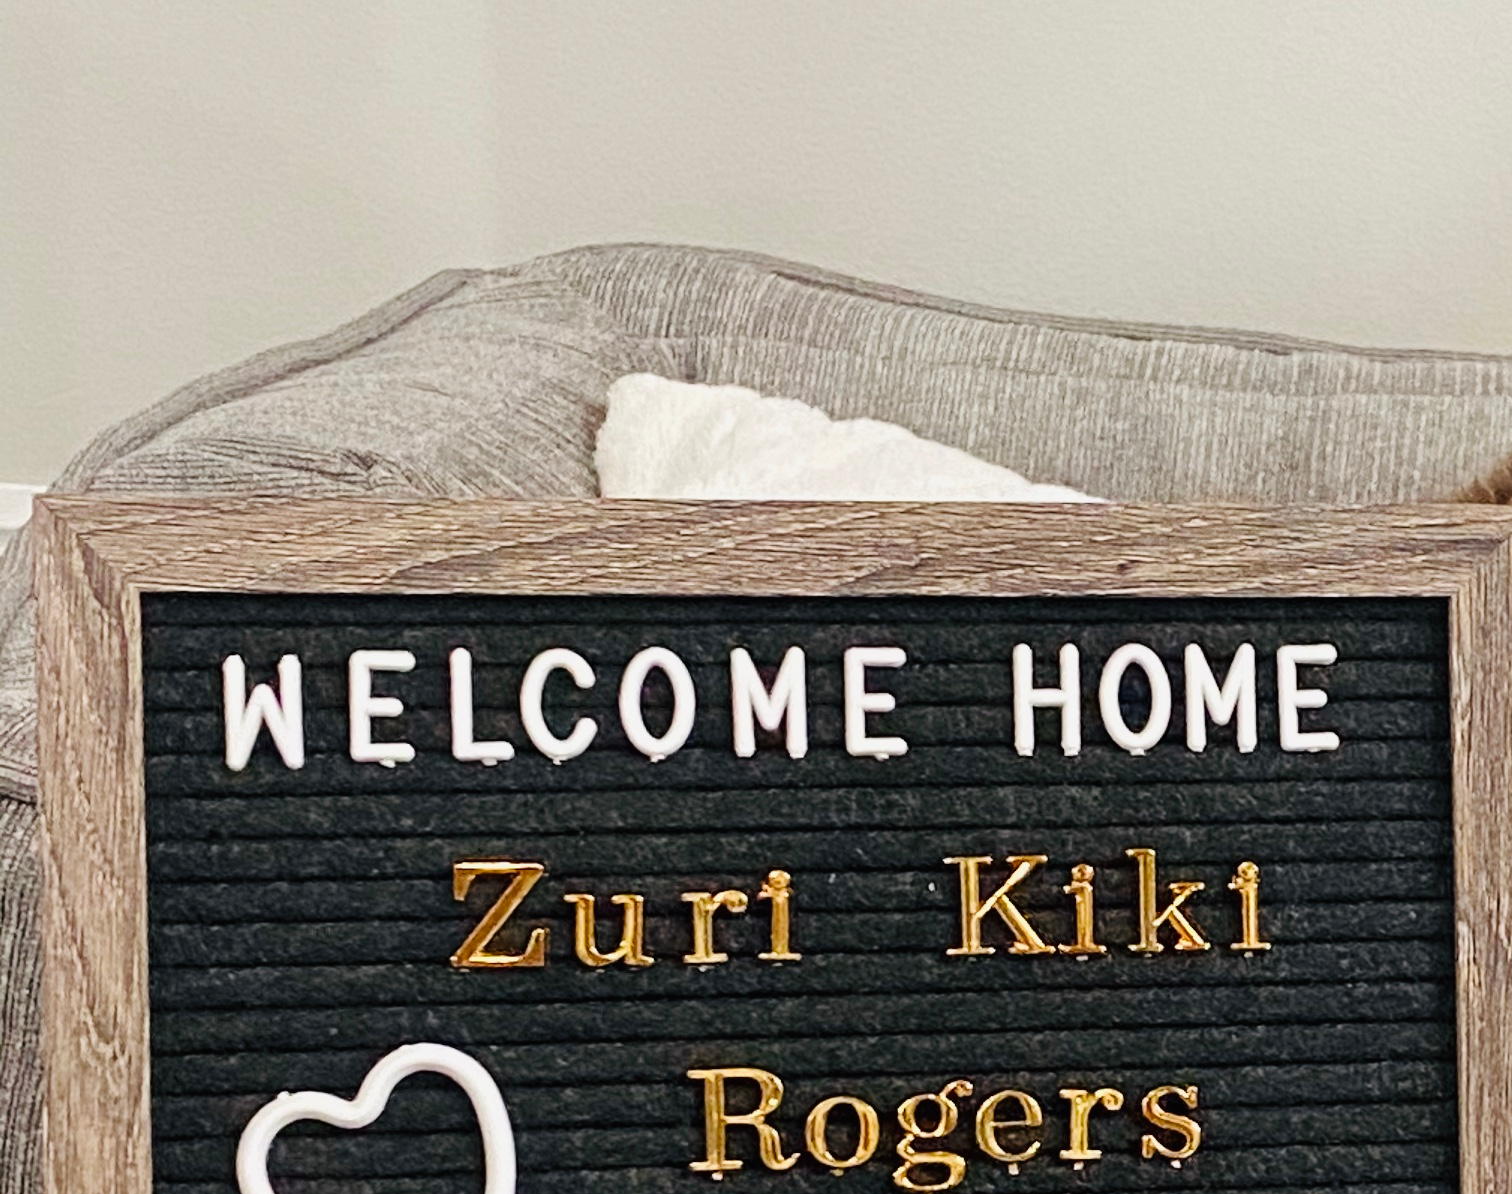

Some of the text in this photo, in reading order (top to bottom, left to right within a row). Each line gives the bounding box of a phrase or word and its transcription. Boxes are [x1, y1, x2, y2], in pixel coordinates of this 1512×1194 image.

[222, 642, 1340, 771] WELCOME HOME
[448, 848, 1272, 970] Zuri Kiki
[686, 1067, 1203, 1193] Rogers
